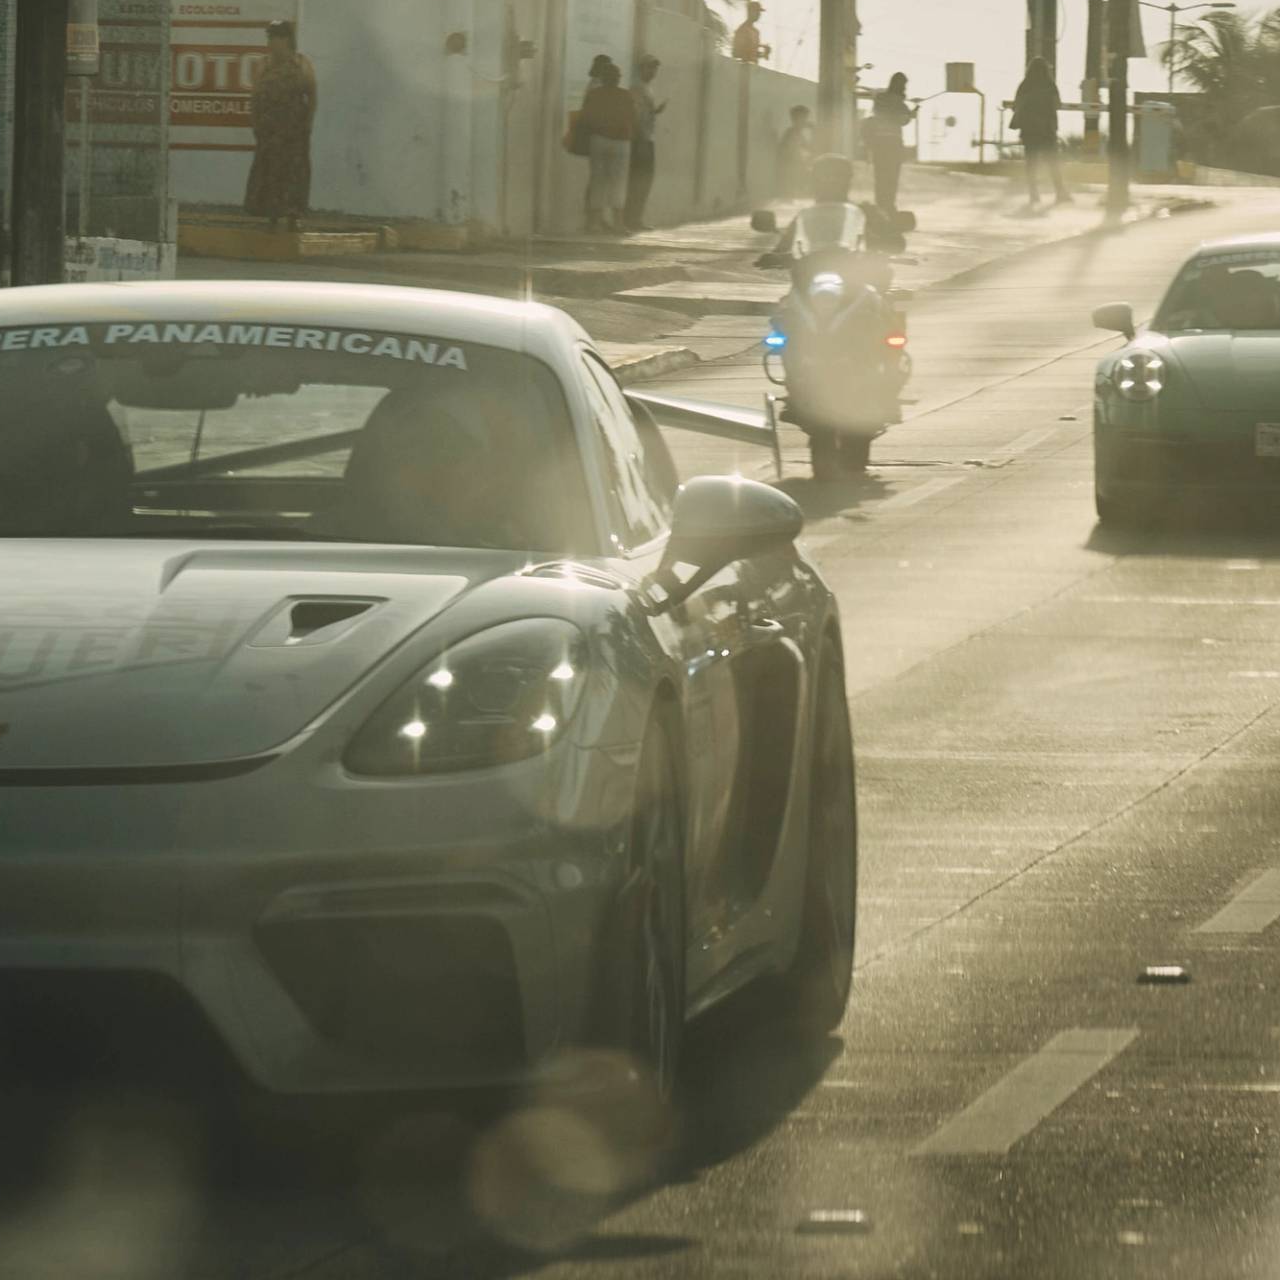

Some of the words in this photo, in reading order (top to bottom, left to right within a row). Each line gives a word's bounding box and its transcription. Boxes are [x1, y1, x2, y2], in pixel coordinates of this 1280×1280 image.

[101, 51, 268, 90] UMOTO
[169, 99, 253, 115] OMERCIALE
[104, 322, 469, 371] PANAMERICANA
